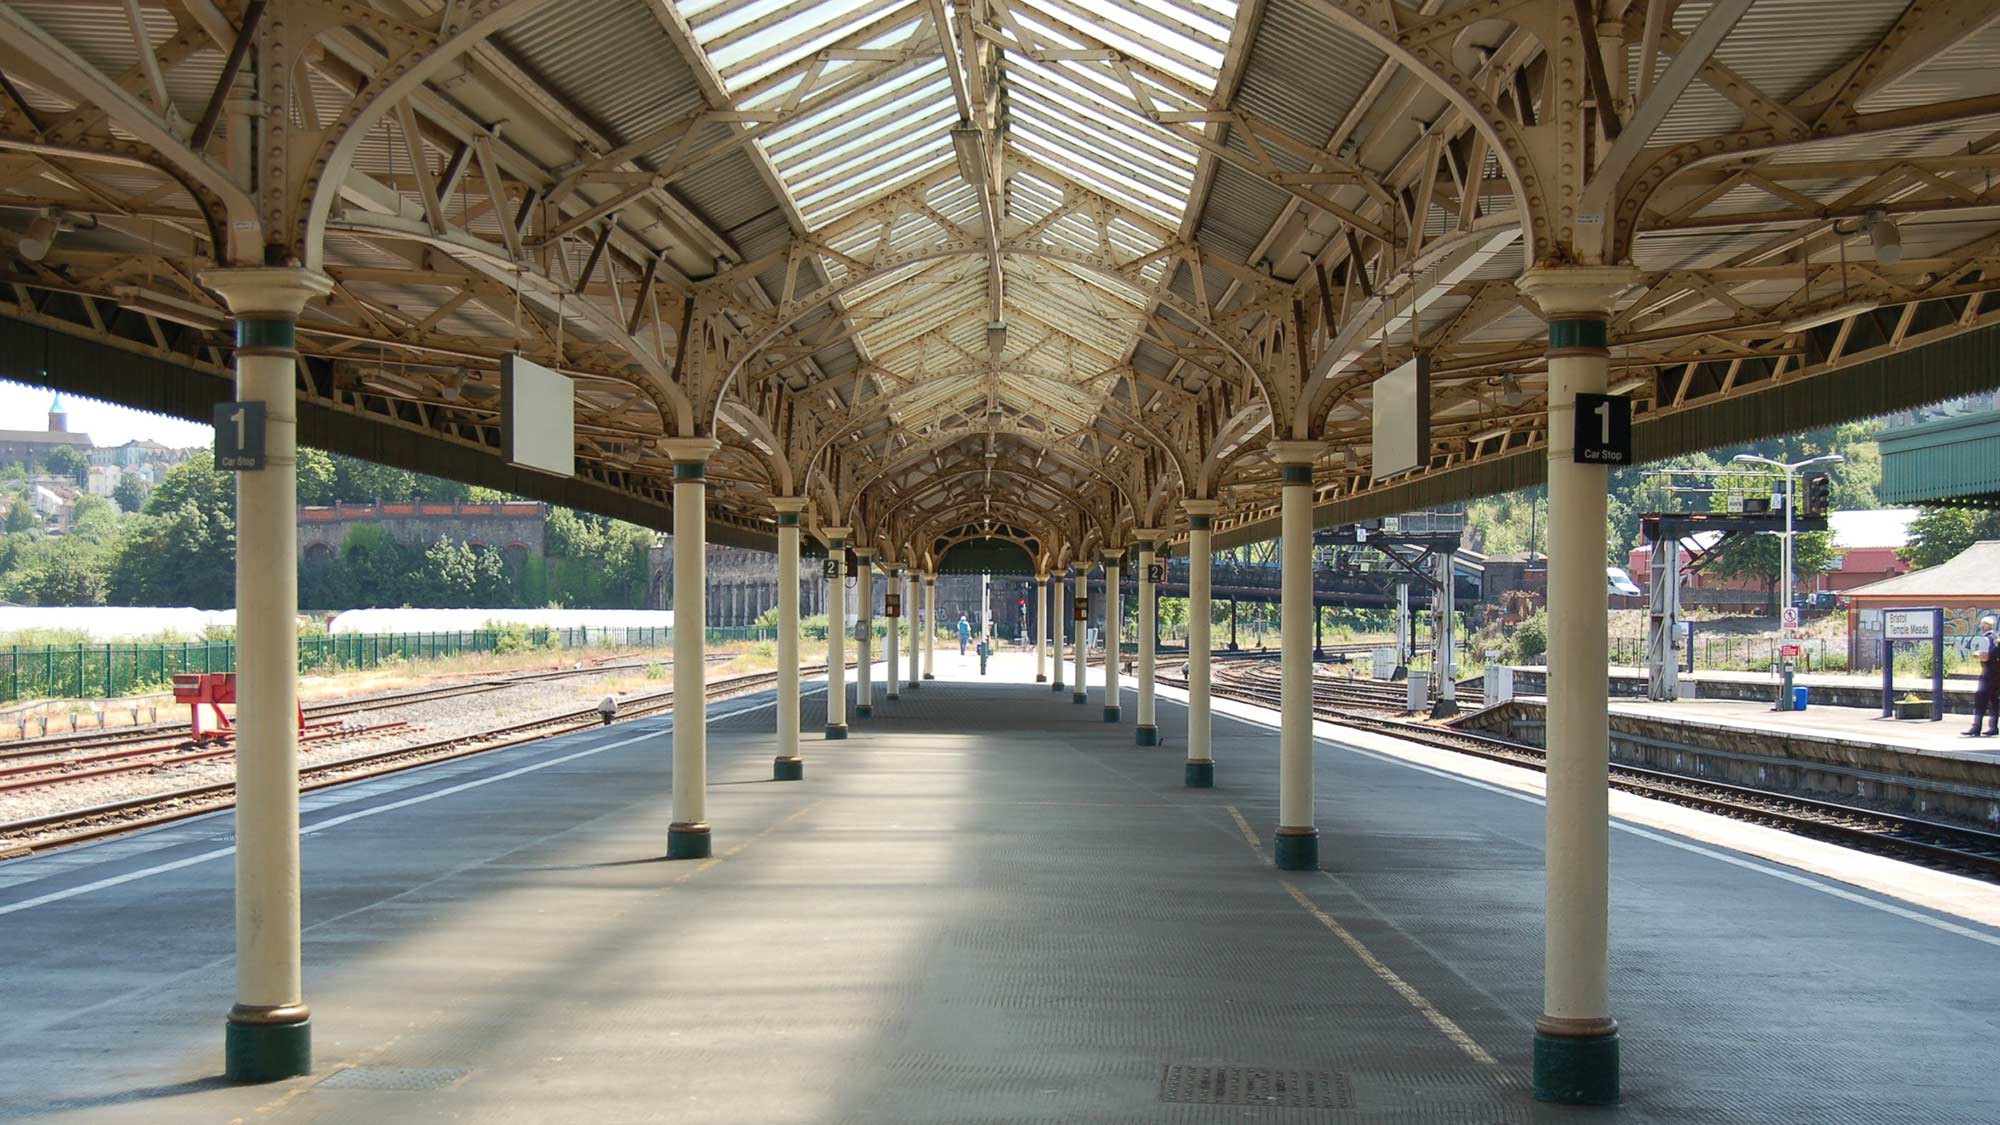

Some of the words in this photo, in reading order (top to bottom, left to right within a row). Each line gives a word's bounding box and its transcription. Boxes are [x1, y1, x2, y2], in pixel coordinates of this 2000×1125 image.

[1594, 401, 1609, 444] 1
[231, 408, 245, 450] 1
[1584, 448, 1600, 459] Car
[1601, 449, 1622, 461] Stop
[222, 456, 236, 466] Car
[237, 456, 256, 468] Stop
[827, 561, 835, 574] 2
[1151, 566, 1159, 578] 2
[1890, 613, 1907, 624] Bristol
[1890, 624, 1909, 635] Temple
[1911, 624, 1929, 634] Meads
